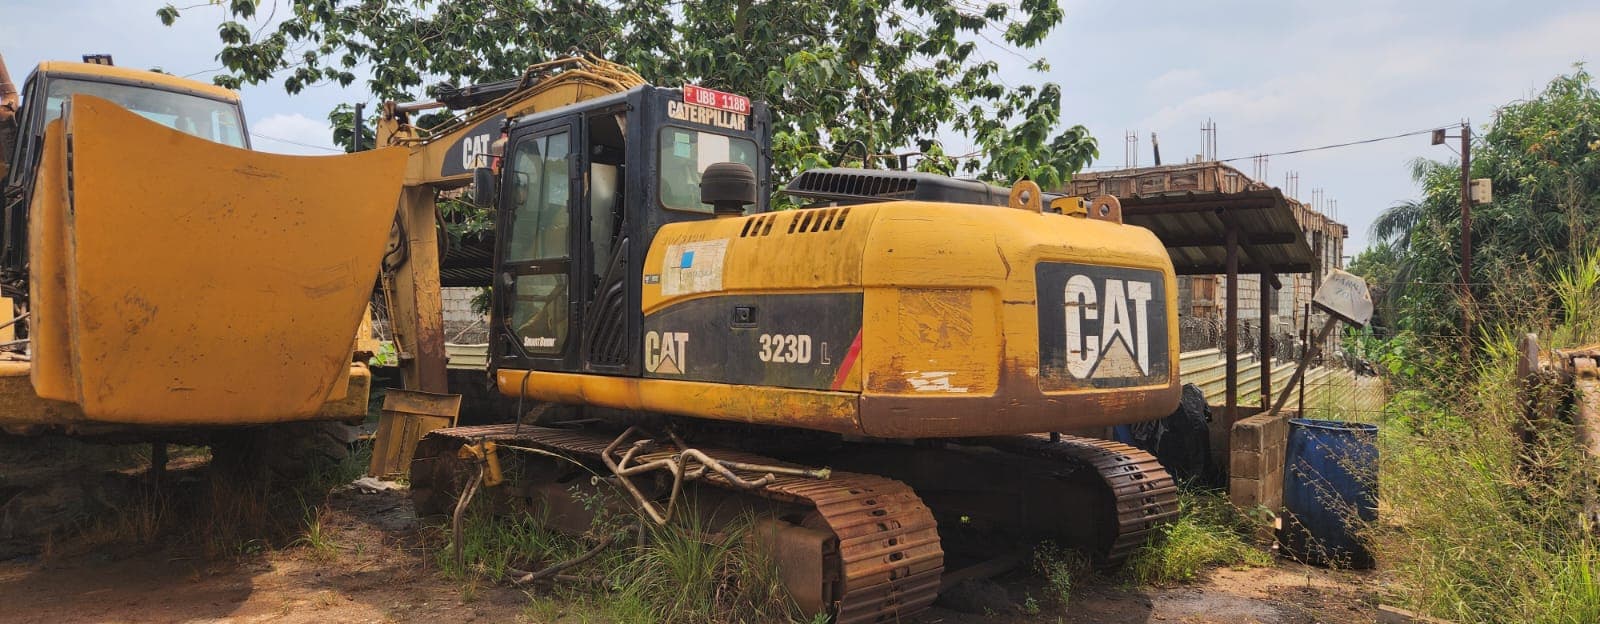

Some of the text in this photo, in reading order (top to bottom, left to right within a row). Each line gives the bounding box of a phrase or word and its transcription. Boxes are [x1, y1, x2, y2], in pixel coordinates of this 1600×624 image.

[696, 89, 715, 106] UBB
[667, 100, 746, 131] CATERPILLAR
[462, 133, 490, 170] CAT
[1064, 274, 1152, 379] CAT
[644, 331, 689, 375] CAT
[759, 334, 831, 365] 323D L
